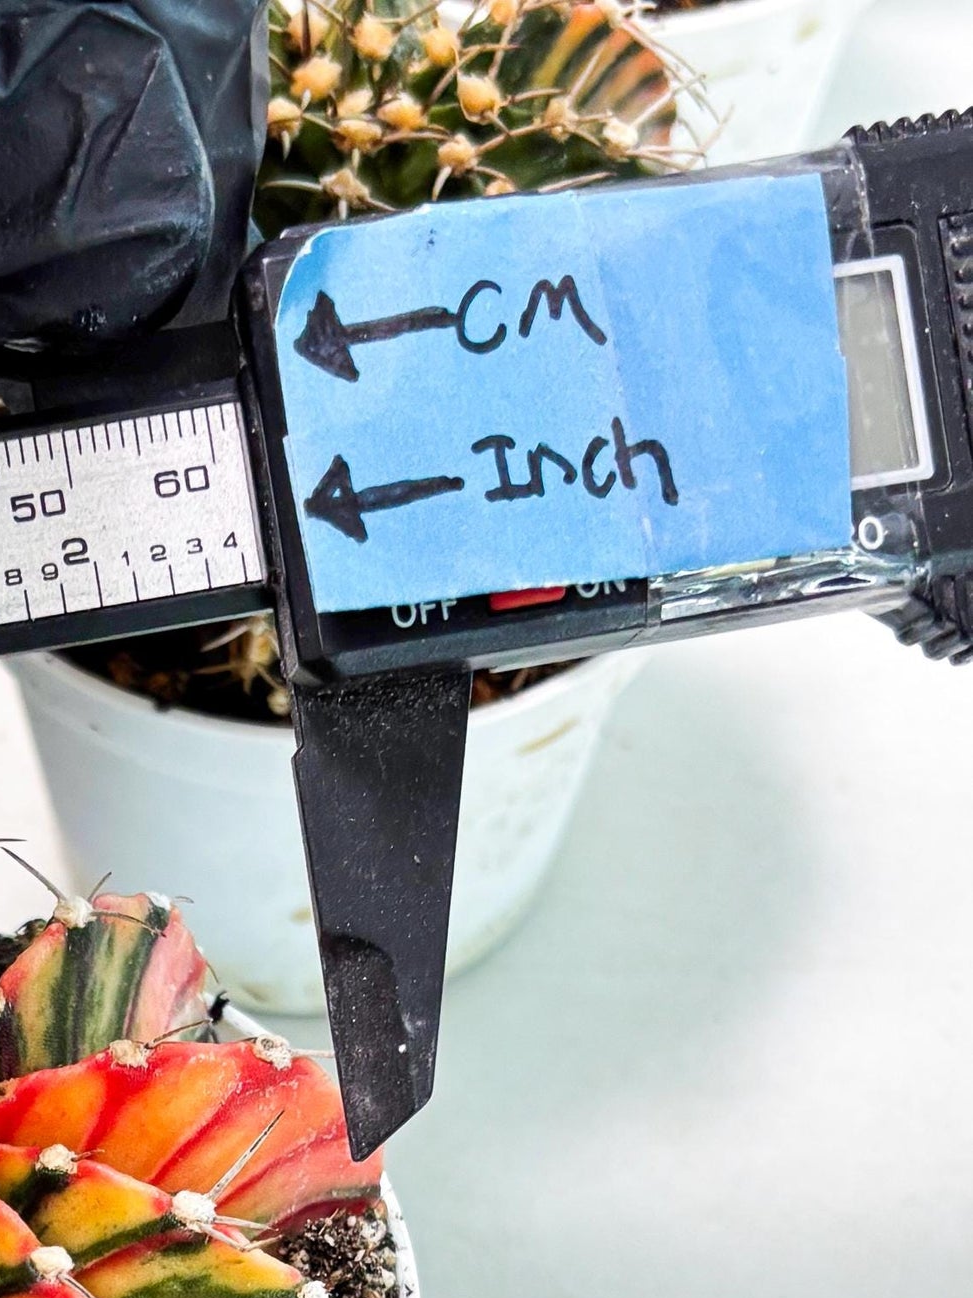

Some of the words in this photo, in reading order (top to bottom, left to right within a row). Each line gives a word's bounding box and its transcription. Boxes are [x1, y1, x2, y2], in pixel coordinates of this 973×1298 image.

[454, 274, 608, 355] CM
[470, 416, 680, 507] Inch
[10, 489, 66, 523] 50
[153, 465, 210, 499] 60
[4, 568, 24, 587] 8
[40, 562, 60, 581] 9
[61, 537, 90, 566] 2
[149, 543, 169, 562] 2
[186, 537, 204, 555] 3
[222, 531, 239, 549] 4
[391, 598, 457, 629] OFF
